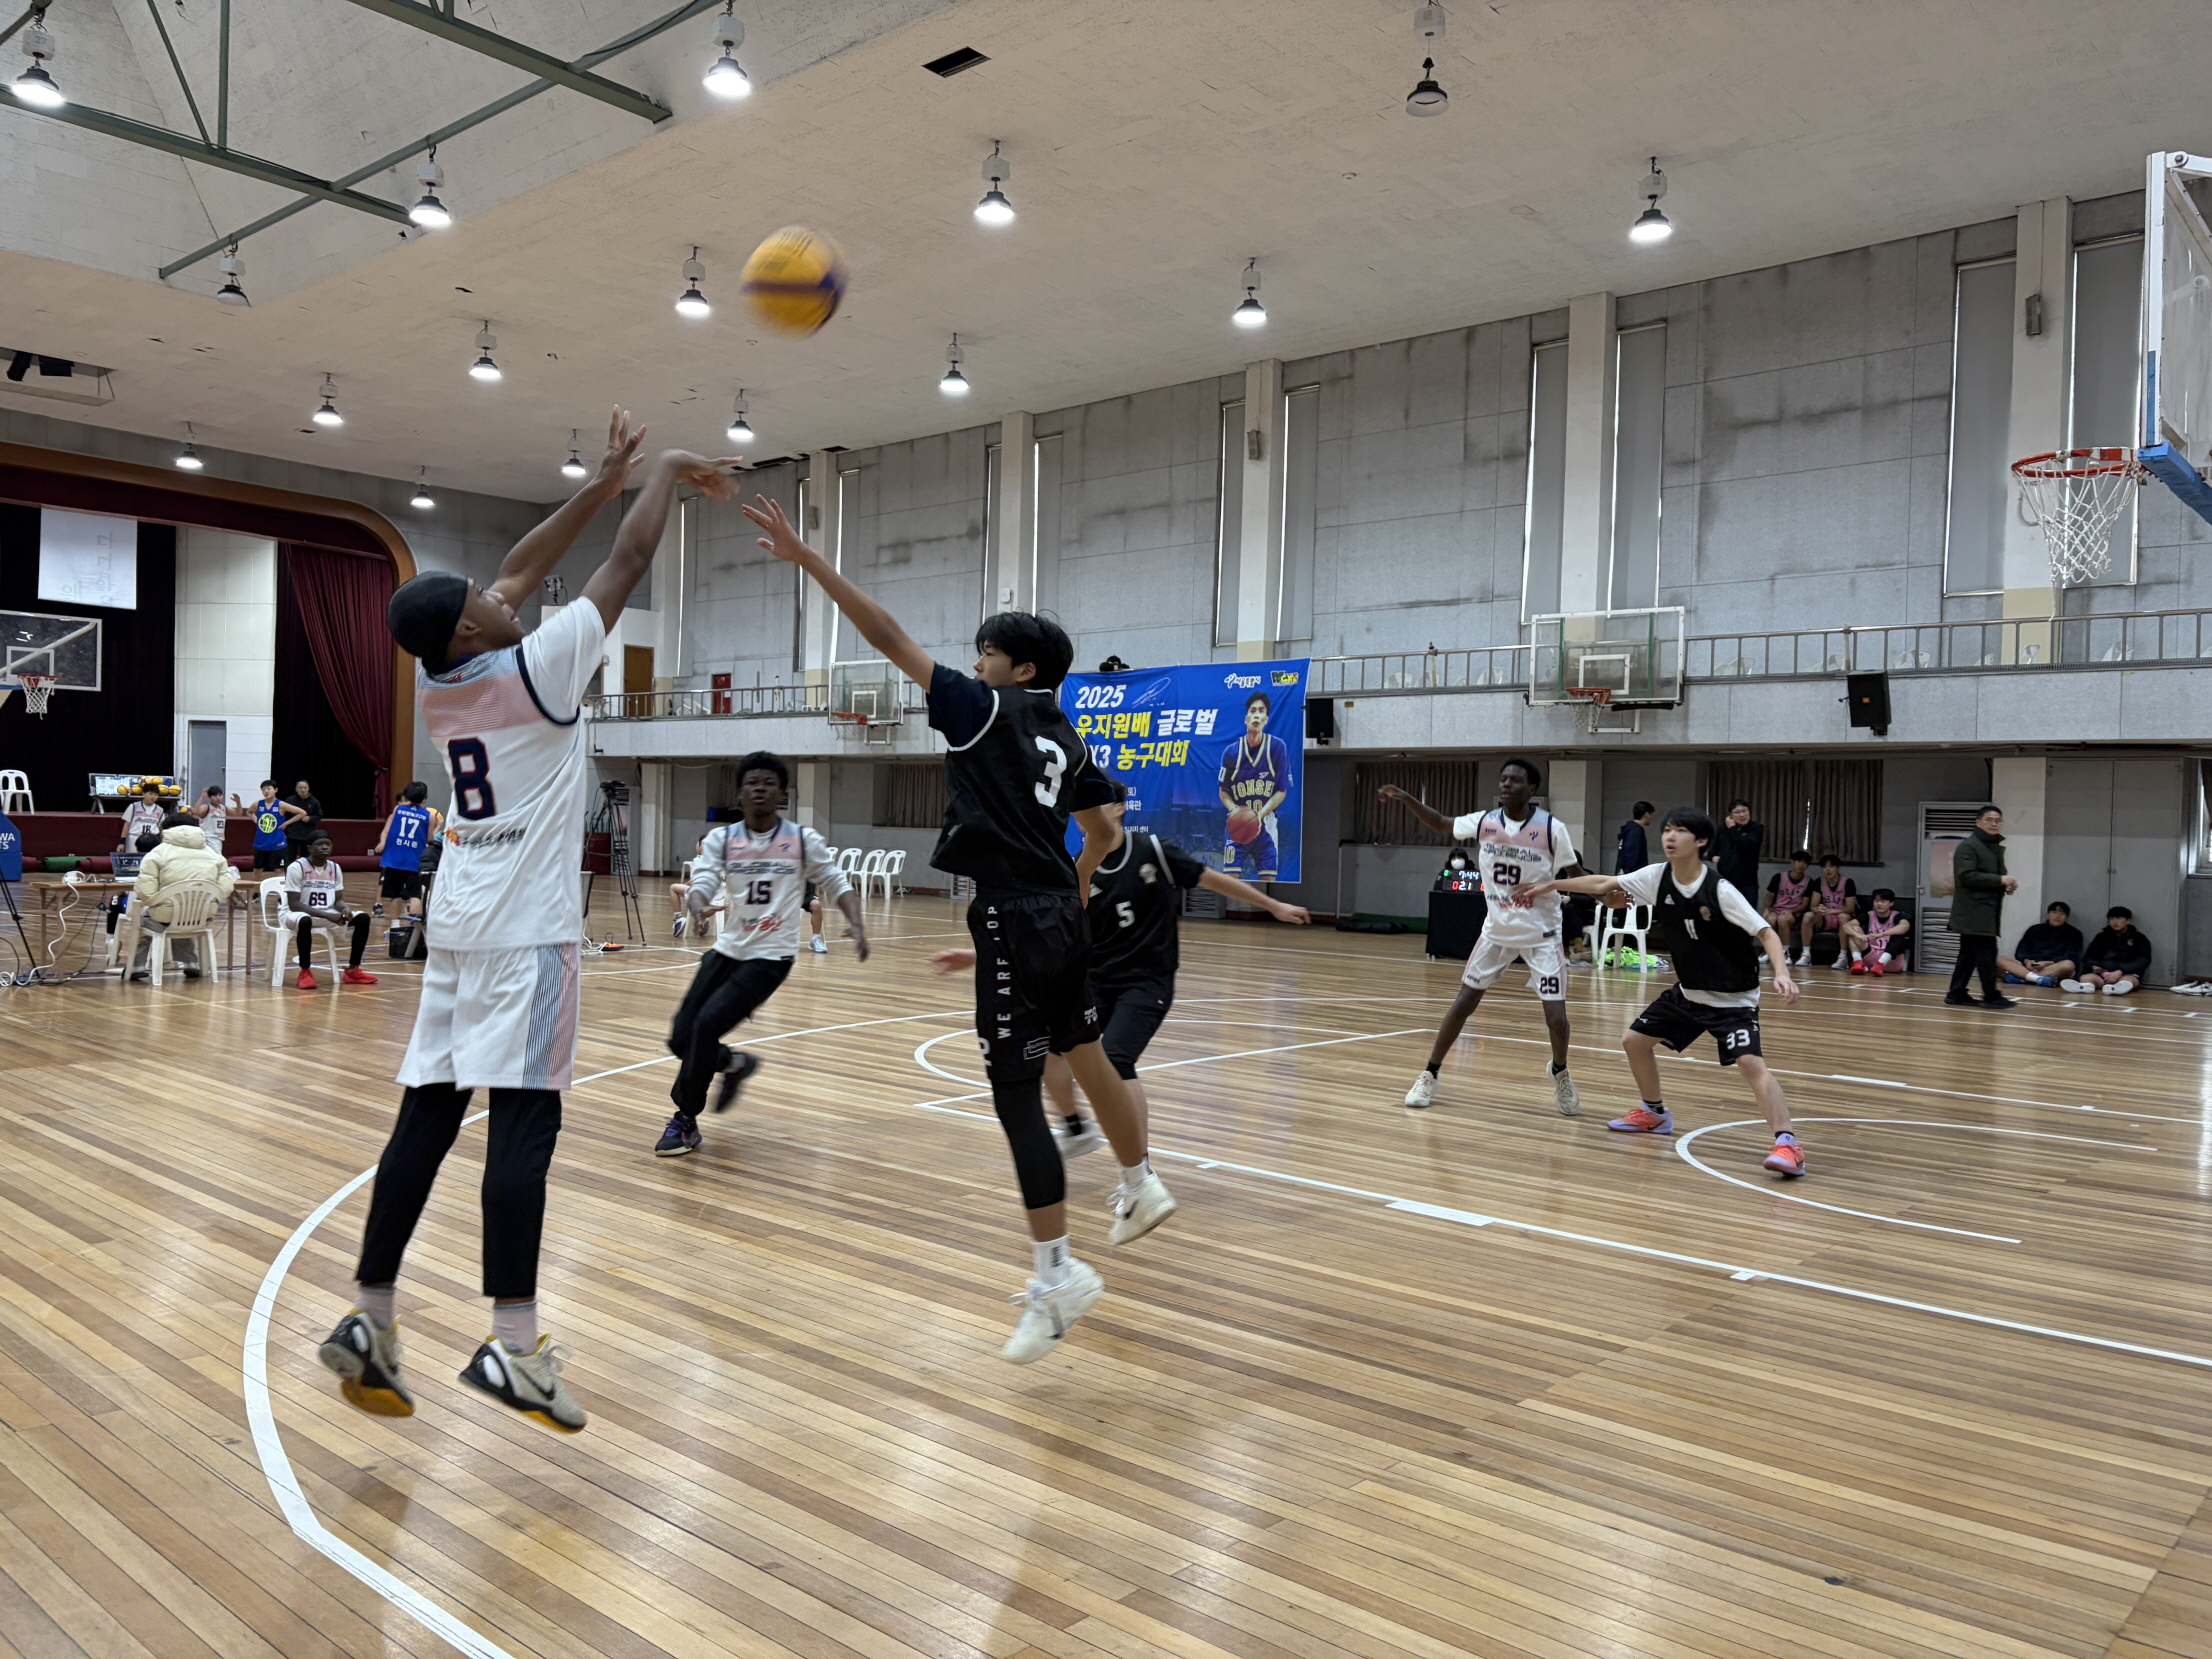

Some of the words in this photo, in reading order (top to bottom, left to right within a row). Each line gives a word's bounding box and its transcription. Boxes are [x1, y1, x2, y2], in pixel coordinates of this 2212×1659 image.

[1075, 684, 1127, 708] 2025
[1075, 711, 1152, 739] 우지원배
[1157, 709, 1218, 736] 글로벌
[1088, 744, 1112, 768] X3
[1116, 739, 1190, 770] 농구대회
[447, 735, 497, 821] 8
[1034, 735, 1067, 808] 3
[398, 816, 420, 839] 17
[1493, 862, 1521, 886] 29
[309, 892, 328, 906] 69
[745, 880, 772, 905] 15
[986, 905, 1001, 942] OP
[1115, 901, 1135, 928] 5
[1540, 976, 1560, 995] 29
[997, 1012, 1012, 1040] WE
[1726, 1029, 1751, 1051] 33
